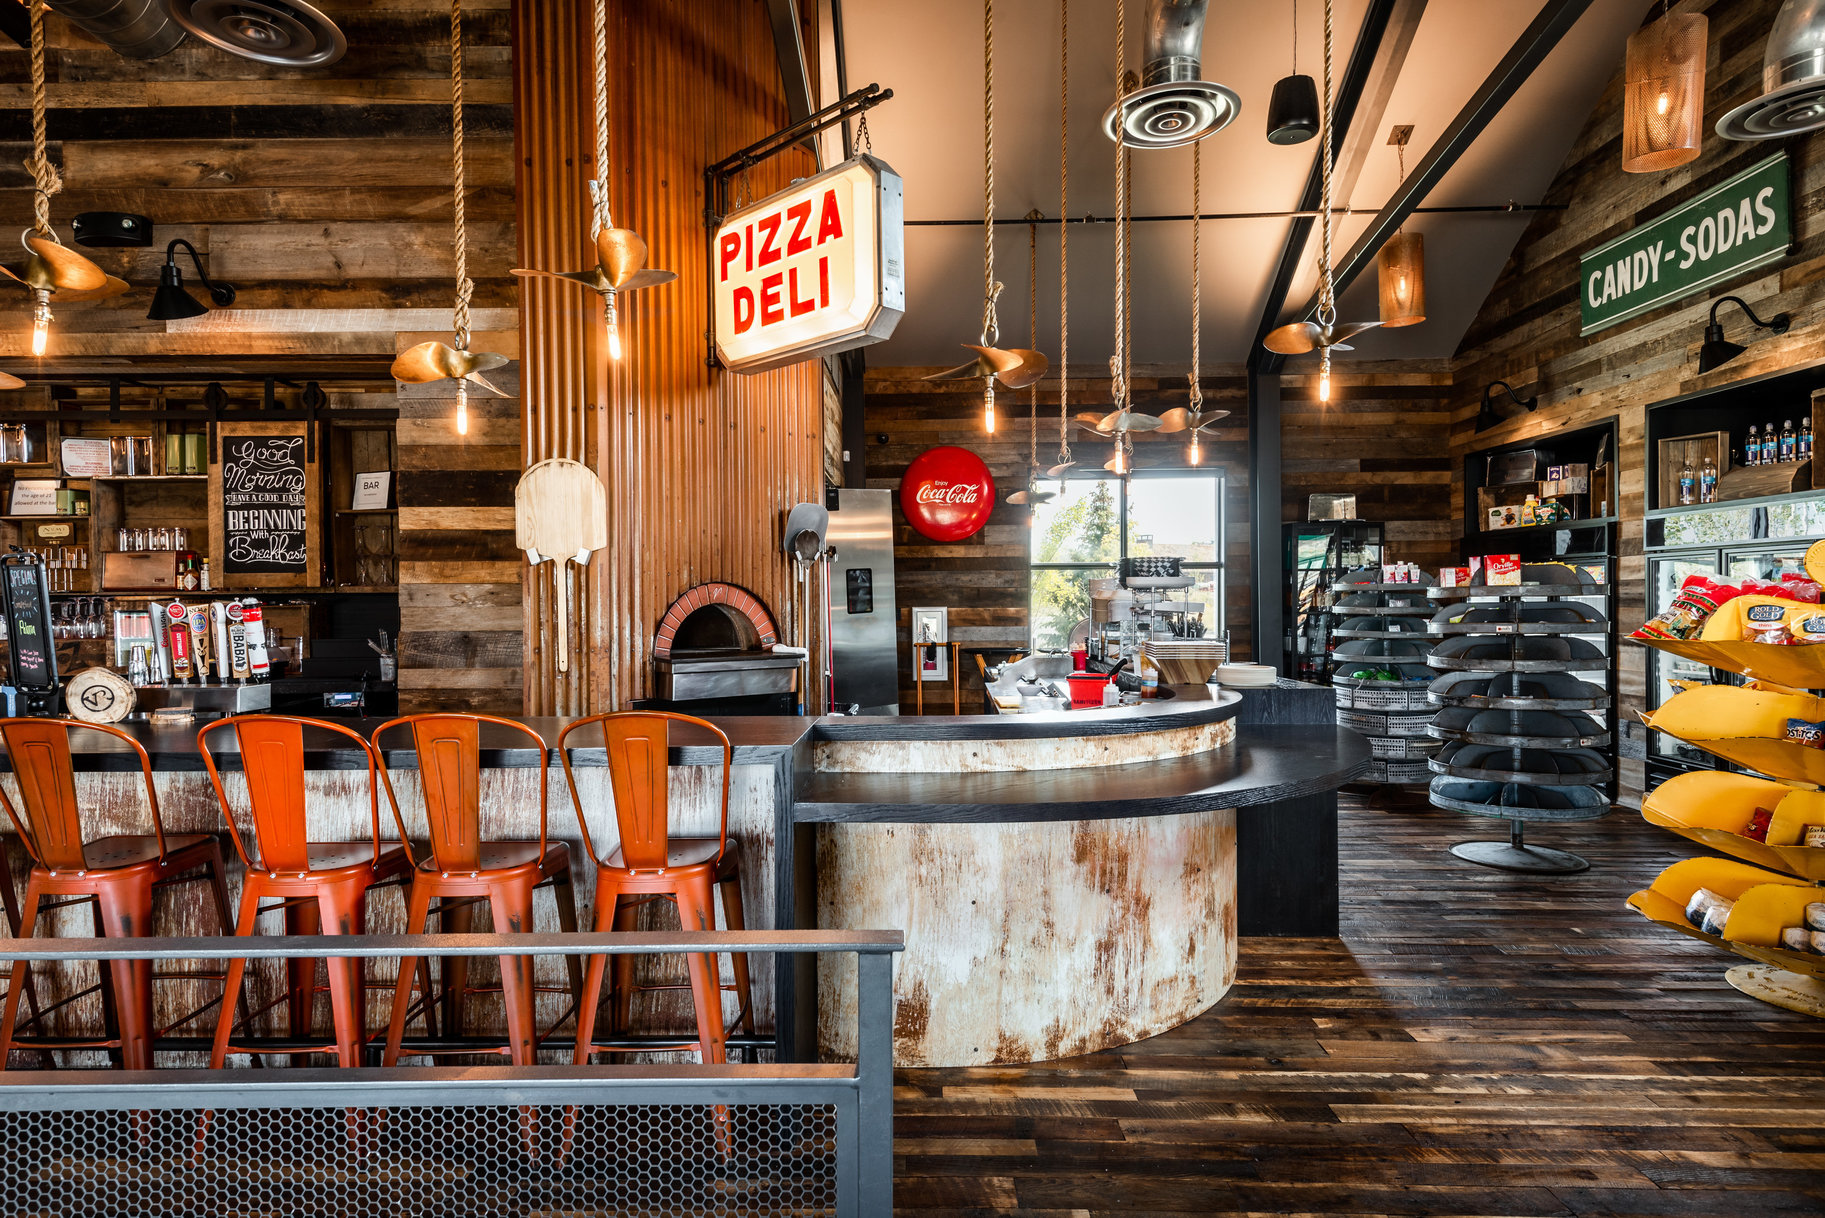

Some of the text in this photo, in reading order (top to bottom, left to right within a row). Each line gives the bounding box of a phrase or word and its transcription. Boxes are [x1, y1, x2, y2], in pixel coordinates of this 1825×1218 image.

[720, 188, 844, 282] PIZZA
[1588, 186, 1776, 309] CANDY-SODAS
[733, 256, 830, 336] DELI
[232, 438, 303, 469] Good
[224, 463, 306, 493] Morning
[363, 481, 380, 490] BAR
[233, 494, 299, 502] HAVE A GOOD DAY
[916, 484, 980, 504] Coca-Cola
[227, 508, 306, 531] BEGINNING
[228, 534, 307, 564] Breakfast
[1493, 561, 1514, 570] Orville
[192, 618, 206, 626] IPA
[1750, 611, 1780, 620] GOLD
[233, 635, 246, 663] BABA
[1787, 728, 1822, 740] OSTITOS
